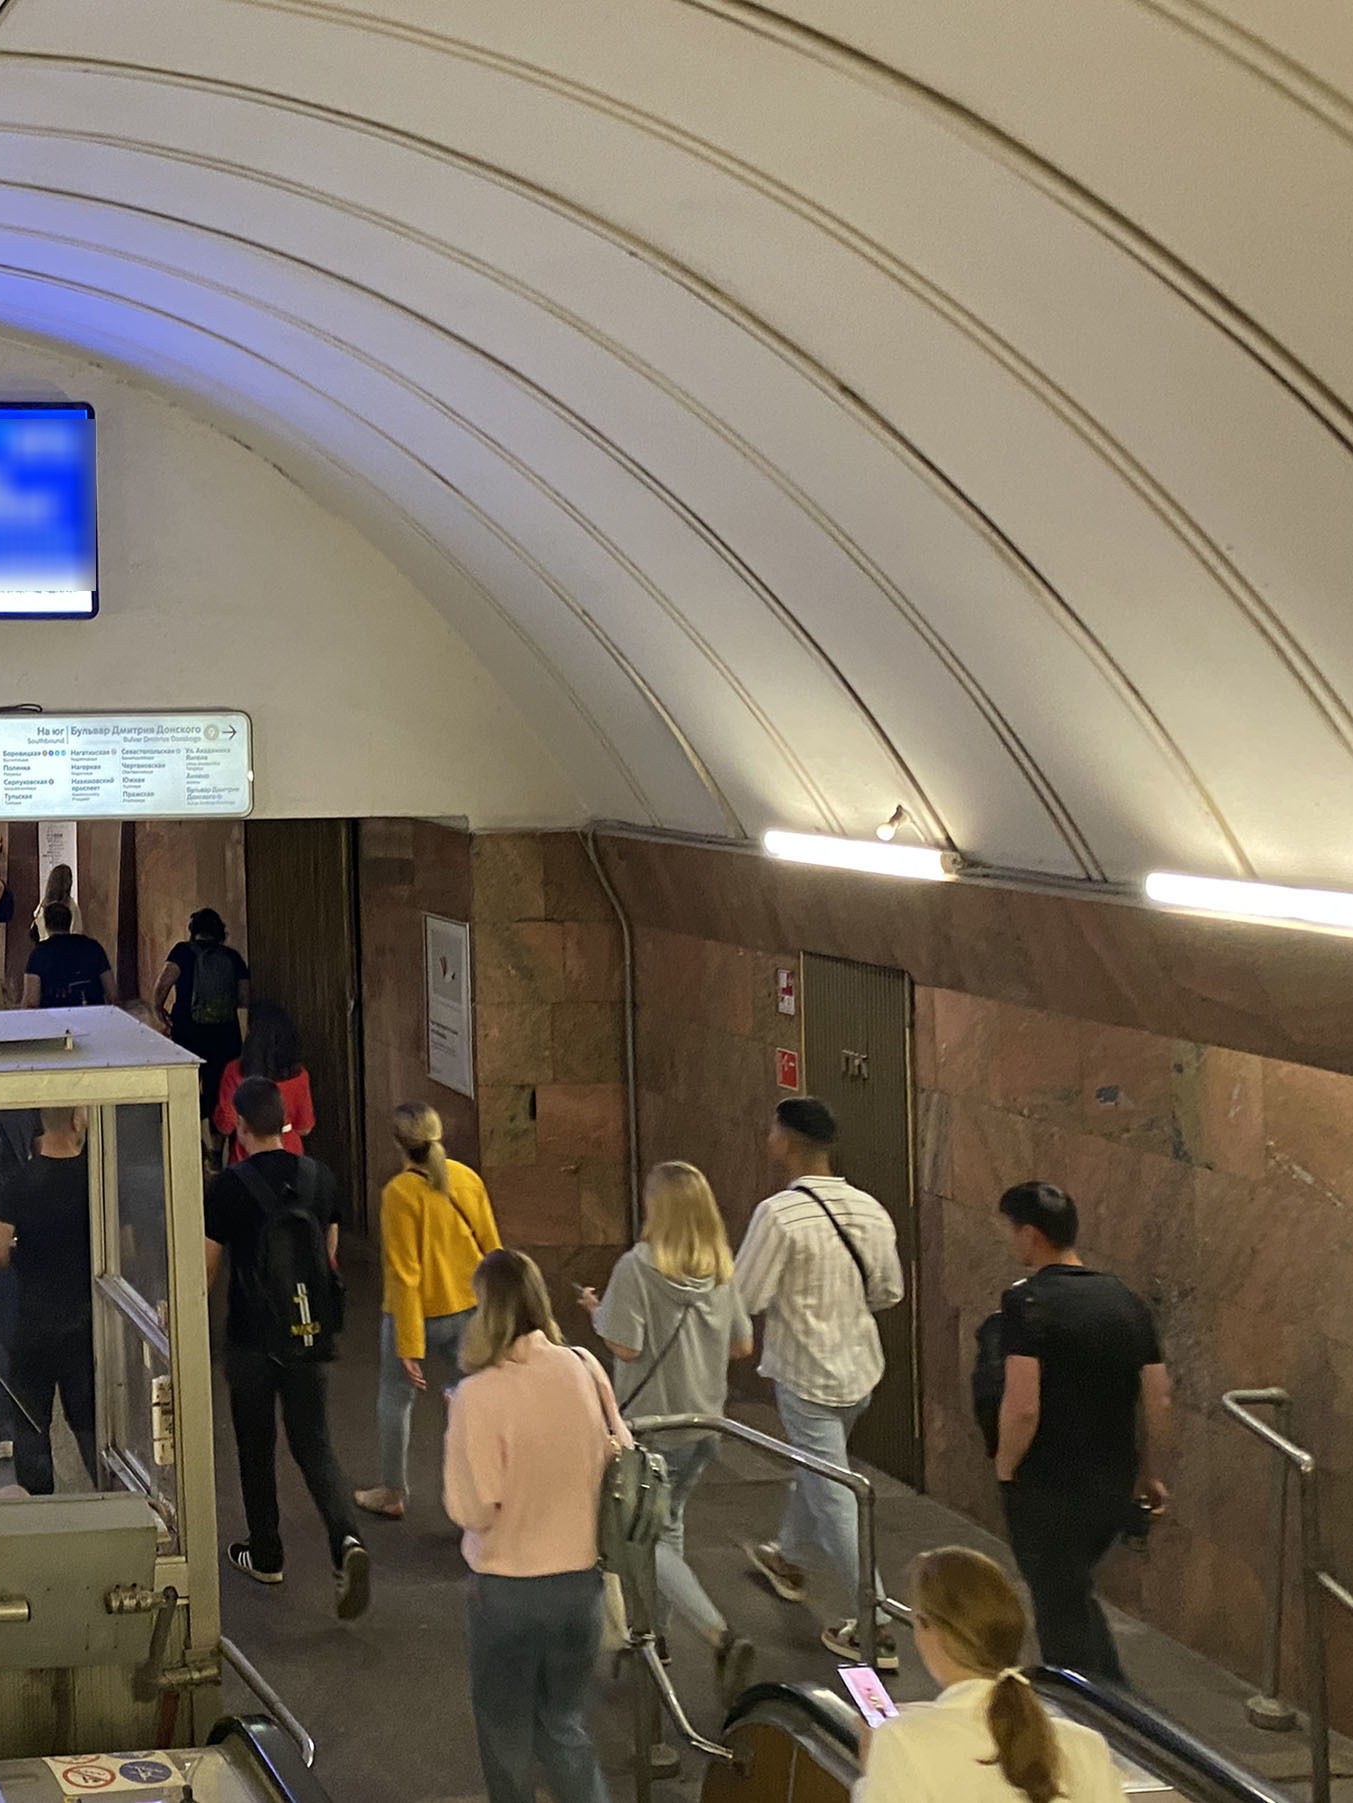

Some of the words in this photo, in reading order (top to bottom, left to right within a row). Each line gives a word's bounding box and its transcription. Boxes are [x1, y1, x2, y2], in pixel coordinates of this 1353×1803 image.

[36, 726, 50, 736] На
[52, 727, 65, 736] юг
[70, 726, 111, 738] Бульвар
[111, 725, 155, 737] Дмитрия
[156, 725, 202, 735] Донского
[27, 737, 65, 745] Southbound
